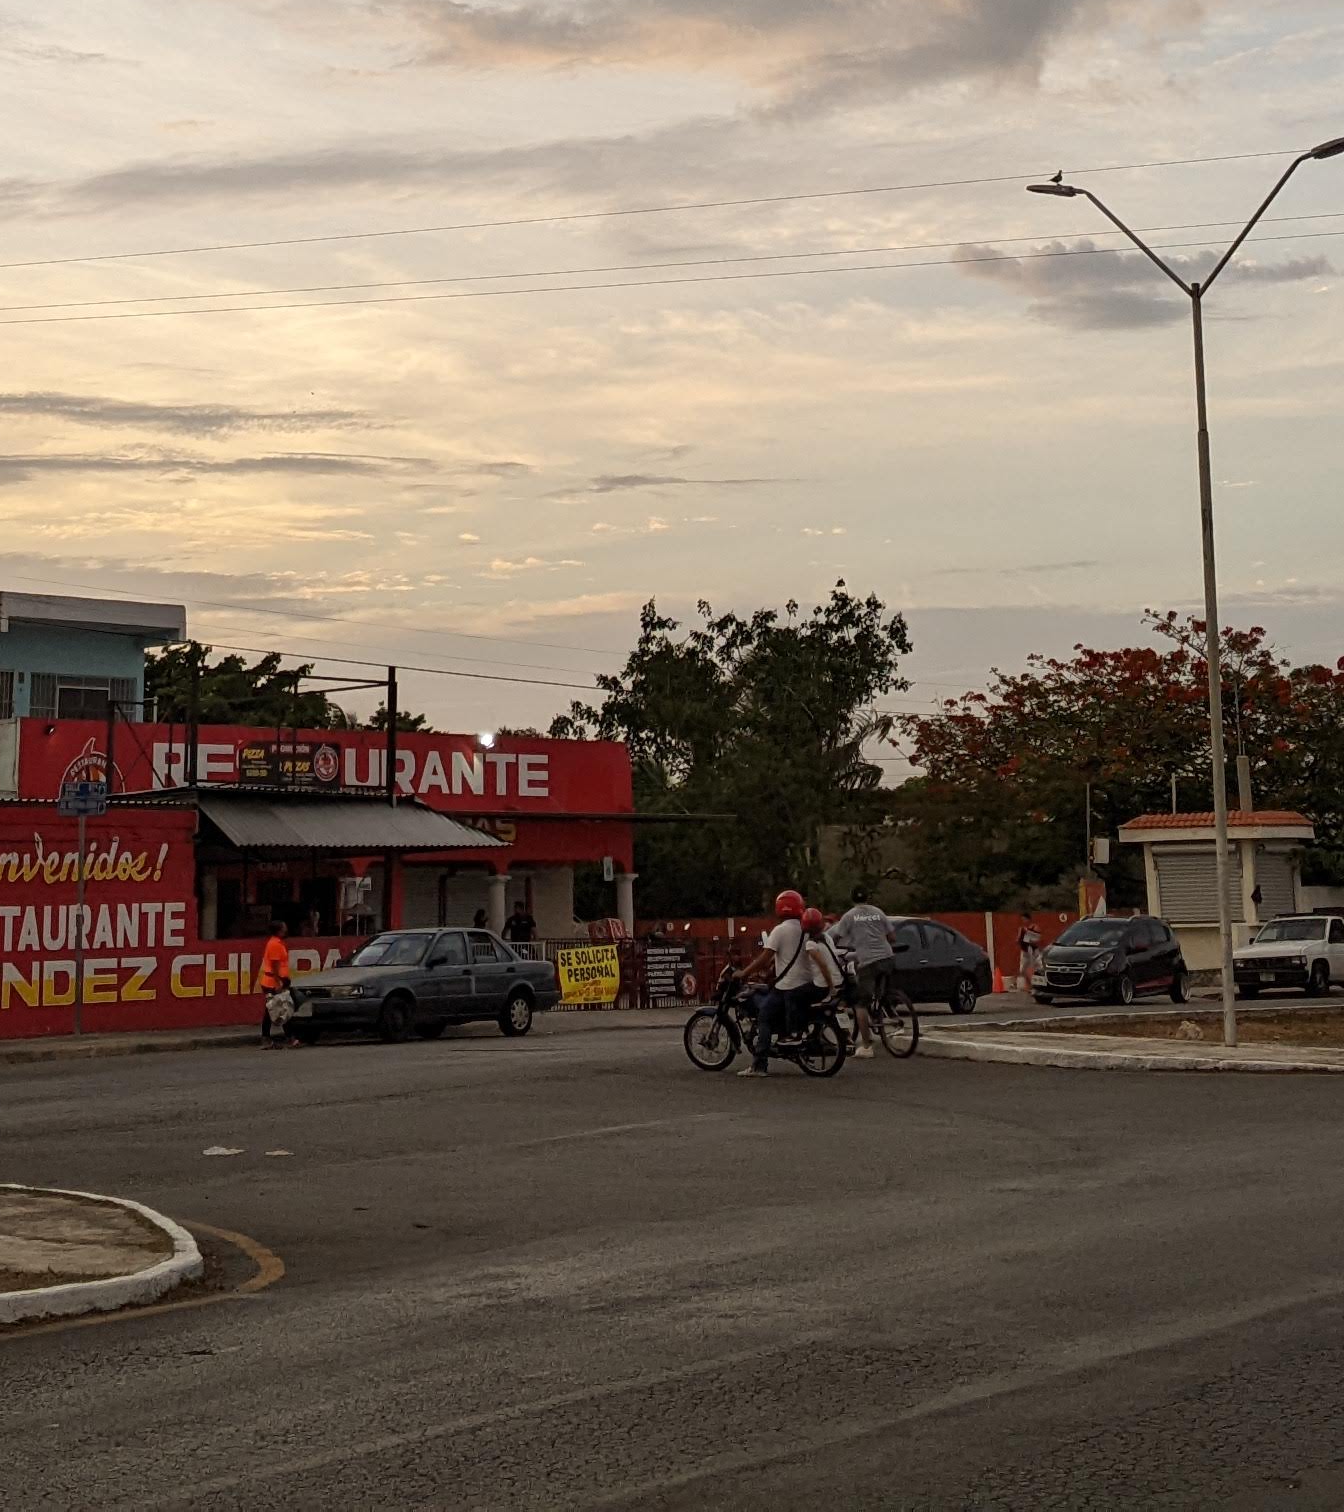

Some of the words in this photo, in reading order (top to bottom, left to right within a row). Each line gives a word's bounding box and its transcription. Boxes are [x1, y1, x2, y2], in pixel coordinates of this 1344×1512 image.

[560, 952, 572, 967] SE
[574, 948, 617, 965] SOLICITA
[567, 963, 616, 983] PERSONAL
